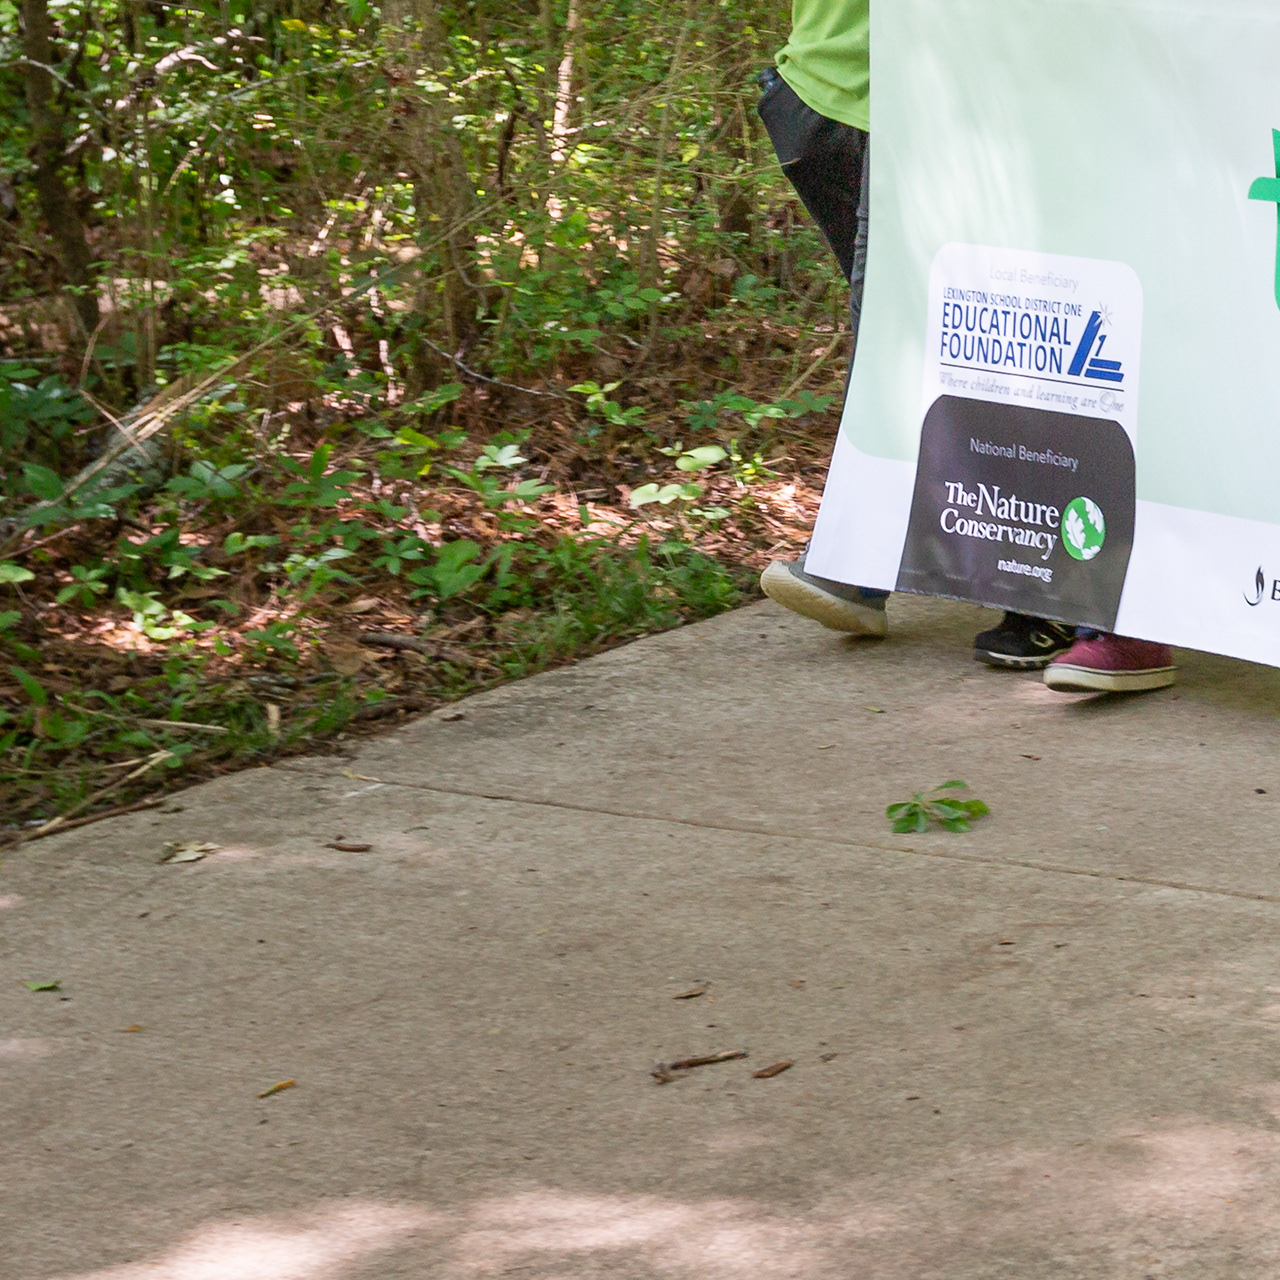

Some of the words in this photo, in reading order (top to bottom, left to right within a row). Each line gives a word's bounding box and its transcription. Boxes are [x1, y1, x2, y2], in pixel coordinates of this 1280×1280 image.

[990, 266, 1016, 282] Local
[1020, 269, 1078, 294] Beneficiary
[943, 287, 988, 304] LEXINGTON
[990, 293, 1022, 309] SCHOOL
[1025, 297, 1062, 314] DISTRICT
[1064, 302, 1083, 318] ONE
[942, 301, 1071, 346] EDUCATIONAL
[940, 331, 1063, 374] FOUNDATION
[971, 376, 1011, 395] children
[1014, 383, 1035, 399] and
[1036, 385, 1078, 410] learning
[1080, 397, 1098, 408] are
[970, 437, 1016, 459] National
[1019, 444, 1079, 472] Beneficiary
[945, 481, 977, 507] The
[975, 482, 1060, 529] Nature
[940, 507, 1058, 560] Conservancy
[997, 558, 1054, 582] nature.org
